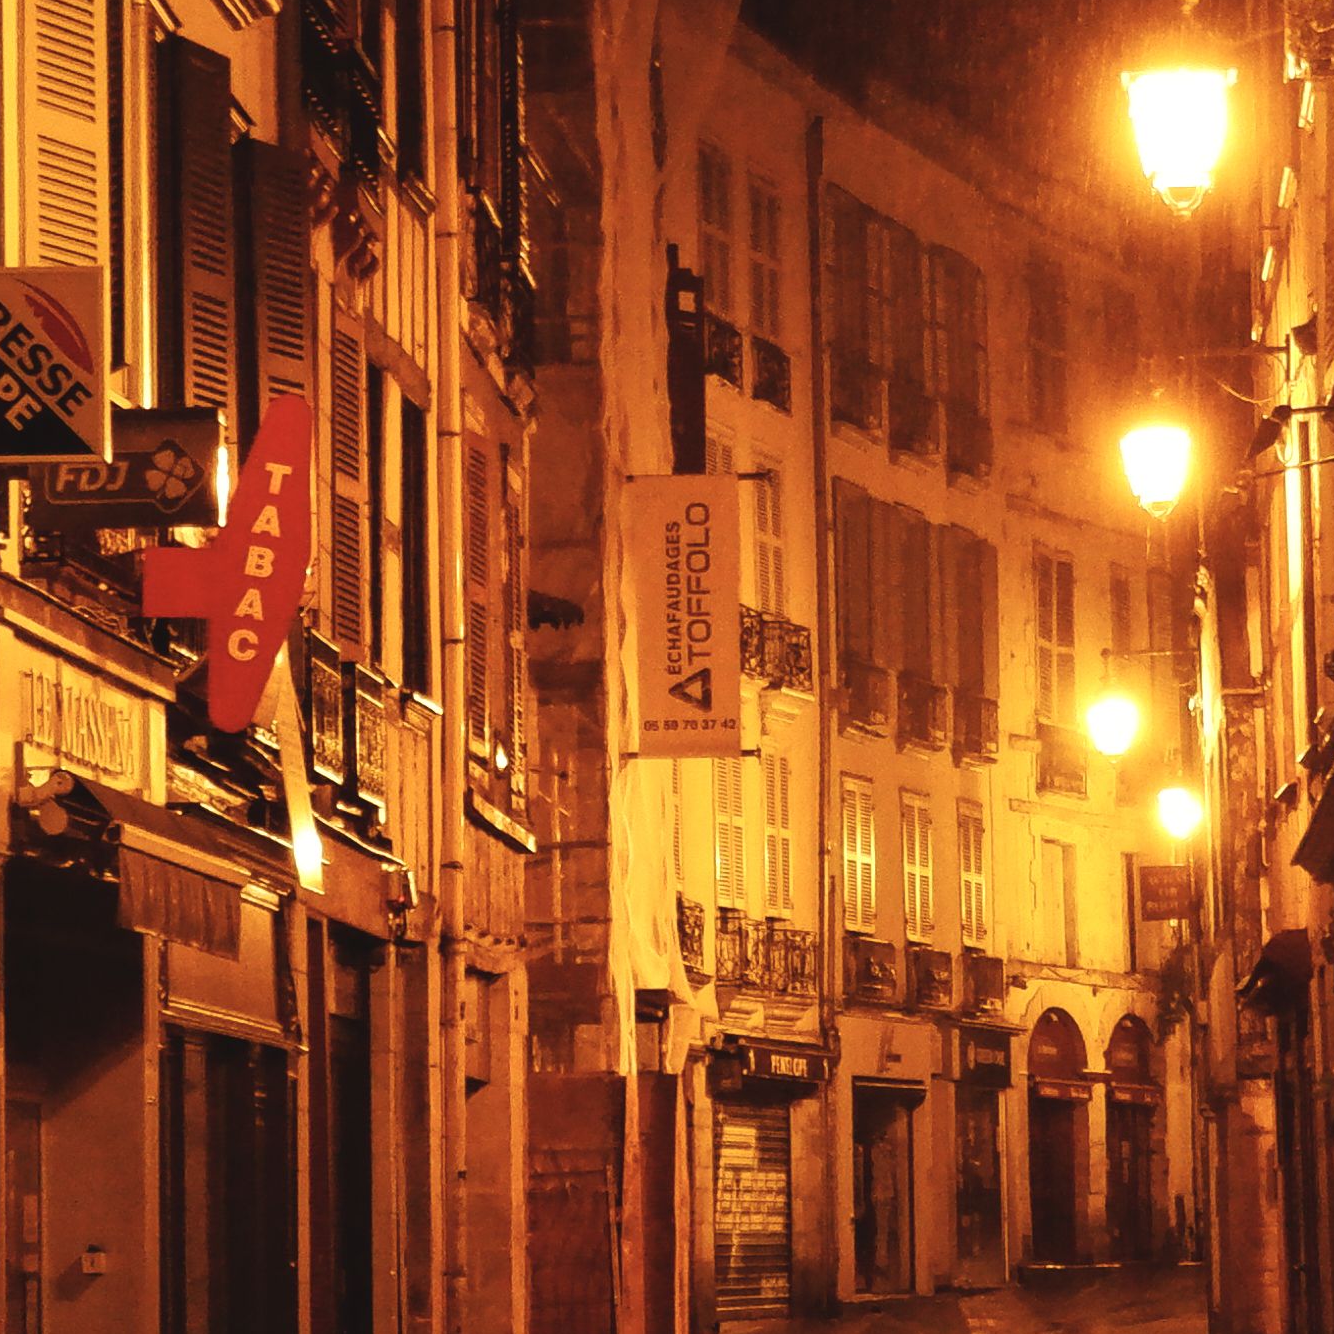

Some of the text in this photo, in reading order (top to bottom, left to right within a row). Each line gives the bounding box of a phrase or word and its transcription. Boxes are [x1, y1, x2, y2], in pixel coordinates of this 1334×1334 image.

[55, 461, 130, 492] FDJ
[228, 463, 292, 661] TABAC
[685, 502, 712, 667] TOFFOLO
